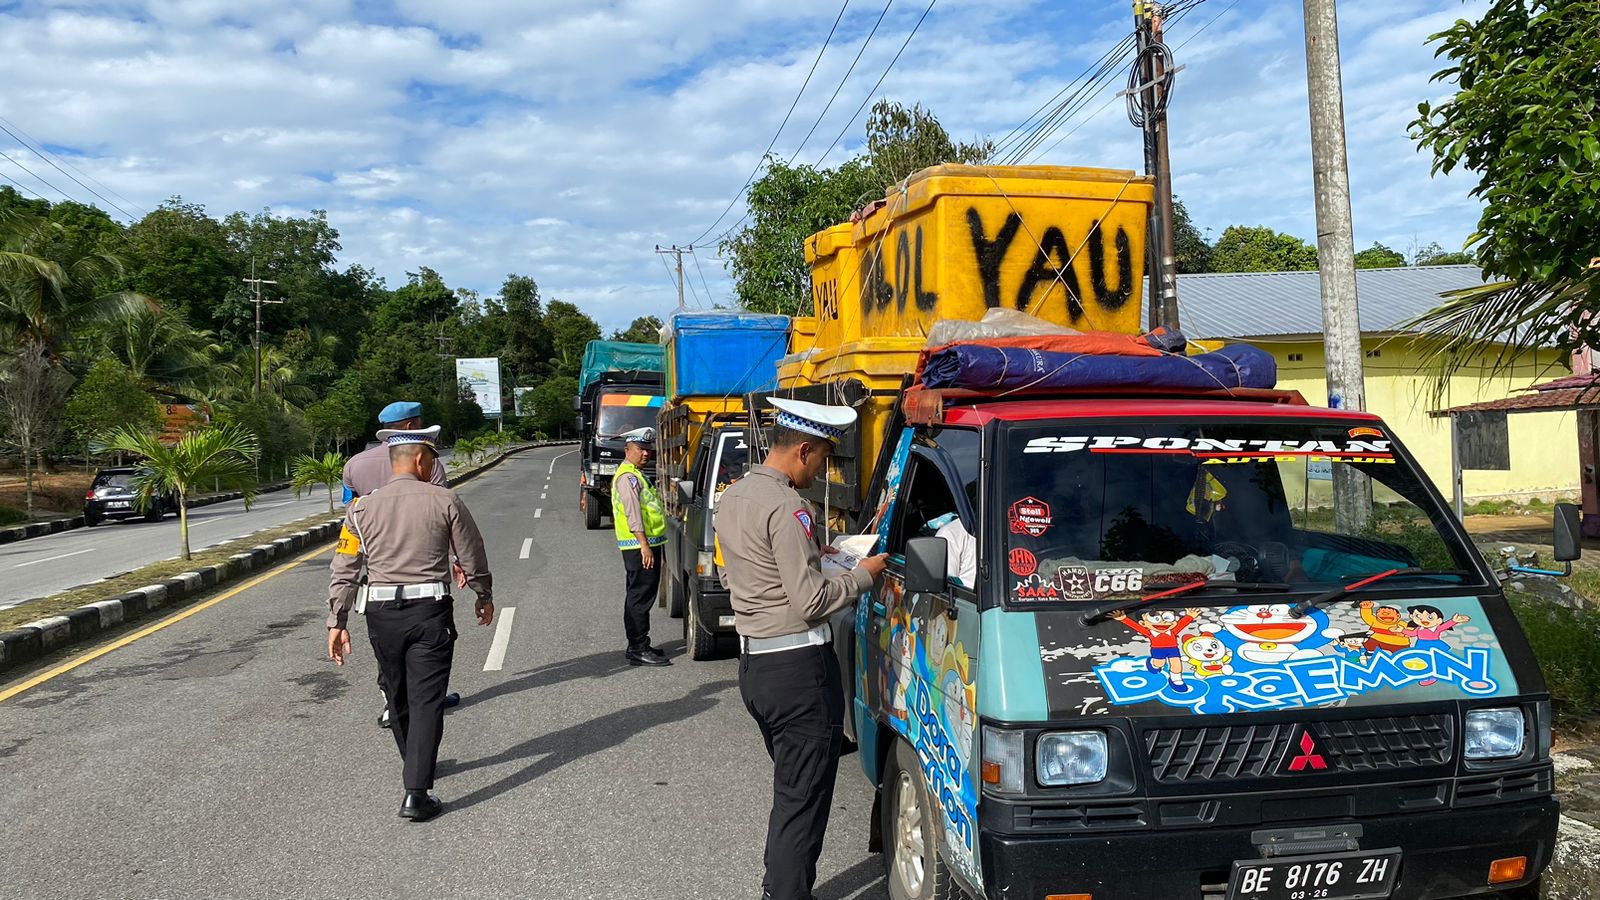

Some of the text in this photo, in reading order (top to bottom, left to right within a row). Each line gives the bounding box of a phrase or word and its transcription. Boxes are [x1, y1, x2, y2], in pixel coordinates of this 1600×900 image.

[966, 206, 1133, 323] YAU
[815, 277, 839, 322] YAU
[1023, 436, 1392, 453] SPONTAN
[1009, 550, 1033, 564] JHN
[1018, 587, 1057, 598] SAKA
[1094, 574, 1143, 592] C66
[915, 677, 961, 791] Dora
[1240, 858, 1389, 894] BE 8176 ZH
